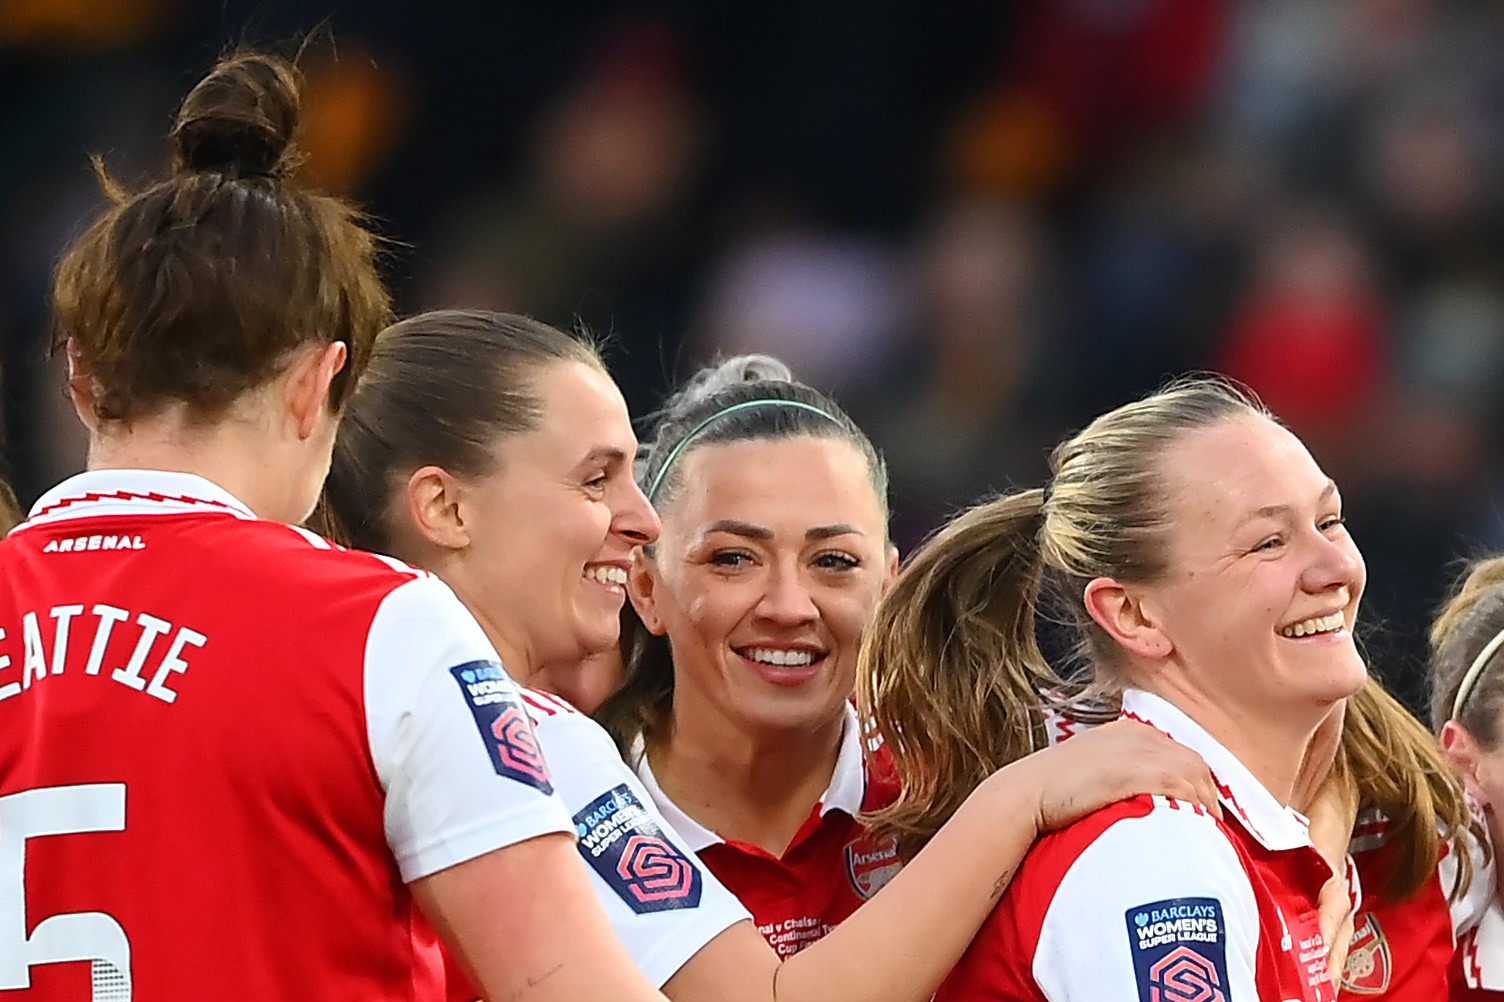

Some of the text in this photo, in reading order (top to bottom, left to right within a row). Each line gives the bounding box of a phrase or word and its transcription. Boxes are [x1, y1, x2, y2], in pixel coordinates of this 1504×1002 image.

[43, 535, 146, 552] ARSENAL
[591, 827, 623, 857] SUPER
[1151, 905, 1216, 923] BARCLAYS
[1136, 918, 1218, 940] WOMEN'S
[1138, 931, 1218, 950] SUPER LEAGUE
